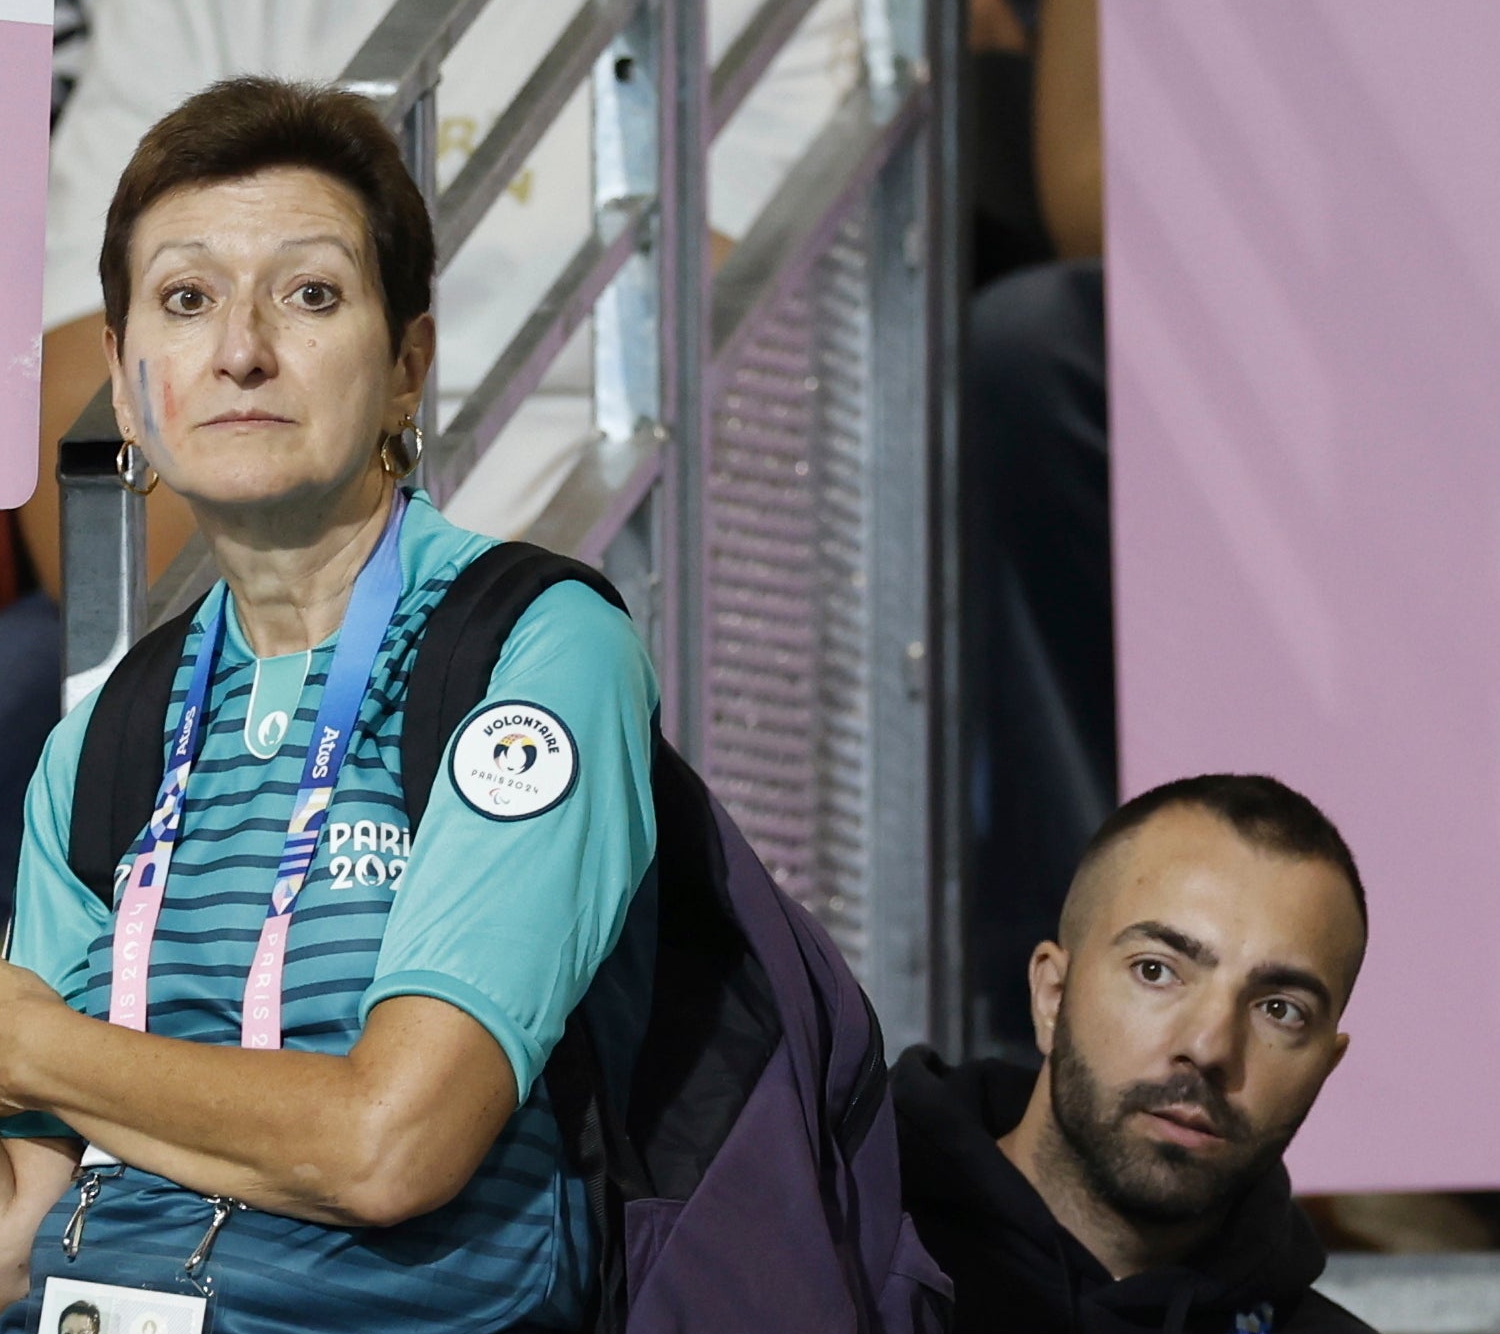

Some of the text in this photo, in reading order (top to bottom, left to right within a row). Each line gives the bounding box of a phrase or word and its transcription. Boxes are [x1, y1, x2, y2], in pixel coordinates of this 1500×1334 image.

[176, 706, 197, 756] Atos
[312, 726, 341, 780] Atos
[483, 715, 560, 755] VOLONTAIRE
[507, 778, 540, 795] 2024
